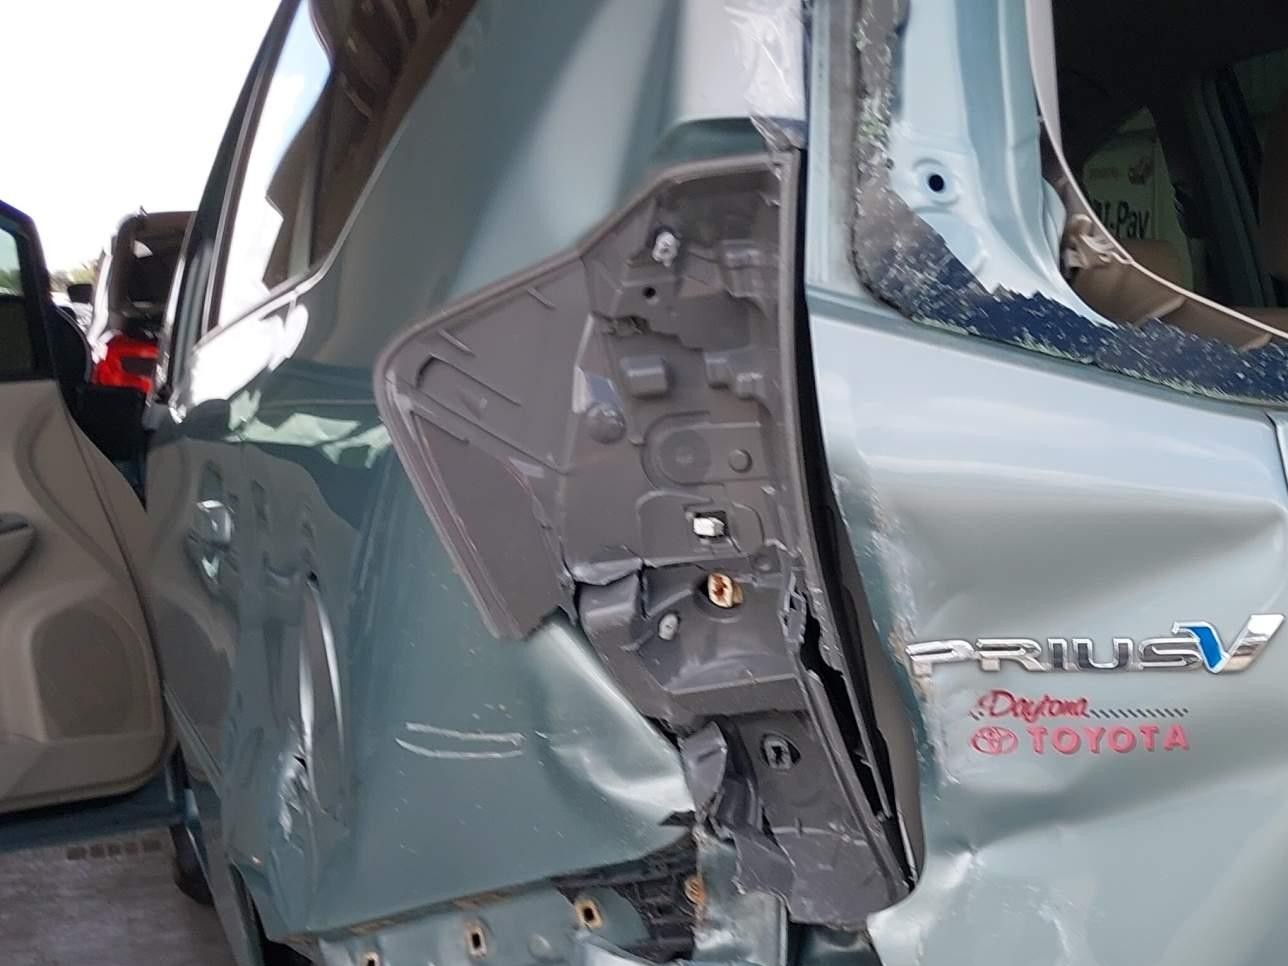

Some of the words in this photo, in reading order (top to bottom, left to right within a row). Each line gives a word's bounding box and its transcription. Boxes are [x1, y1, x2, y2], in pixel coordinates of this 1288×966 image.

[905, 638, 1202, 673] PRIUS
[978, 690, 1089, 722] Daytona
[1027, 726, 1190, 754] TOYOTA
